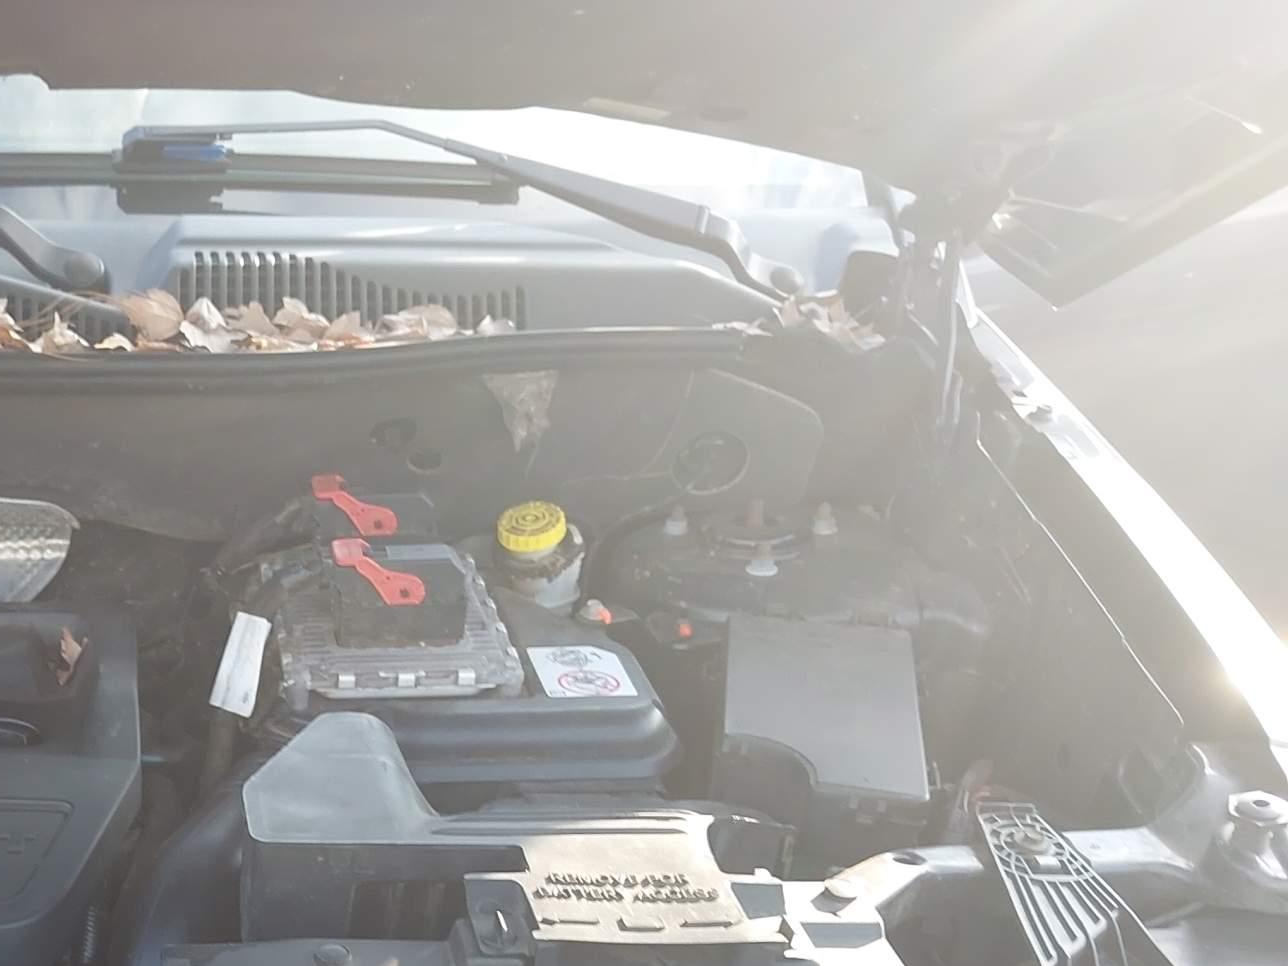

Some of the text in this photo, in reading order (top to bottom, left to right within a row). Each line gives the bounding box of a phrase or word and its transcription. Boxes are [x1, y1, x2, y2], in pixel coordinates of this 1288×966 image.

[545, 872, 689, 888] REMOVE FOR
[632, 887, 719, 904] ACCESS
